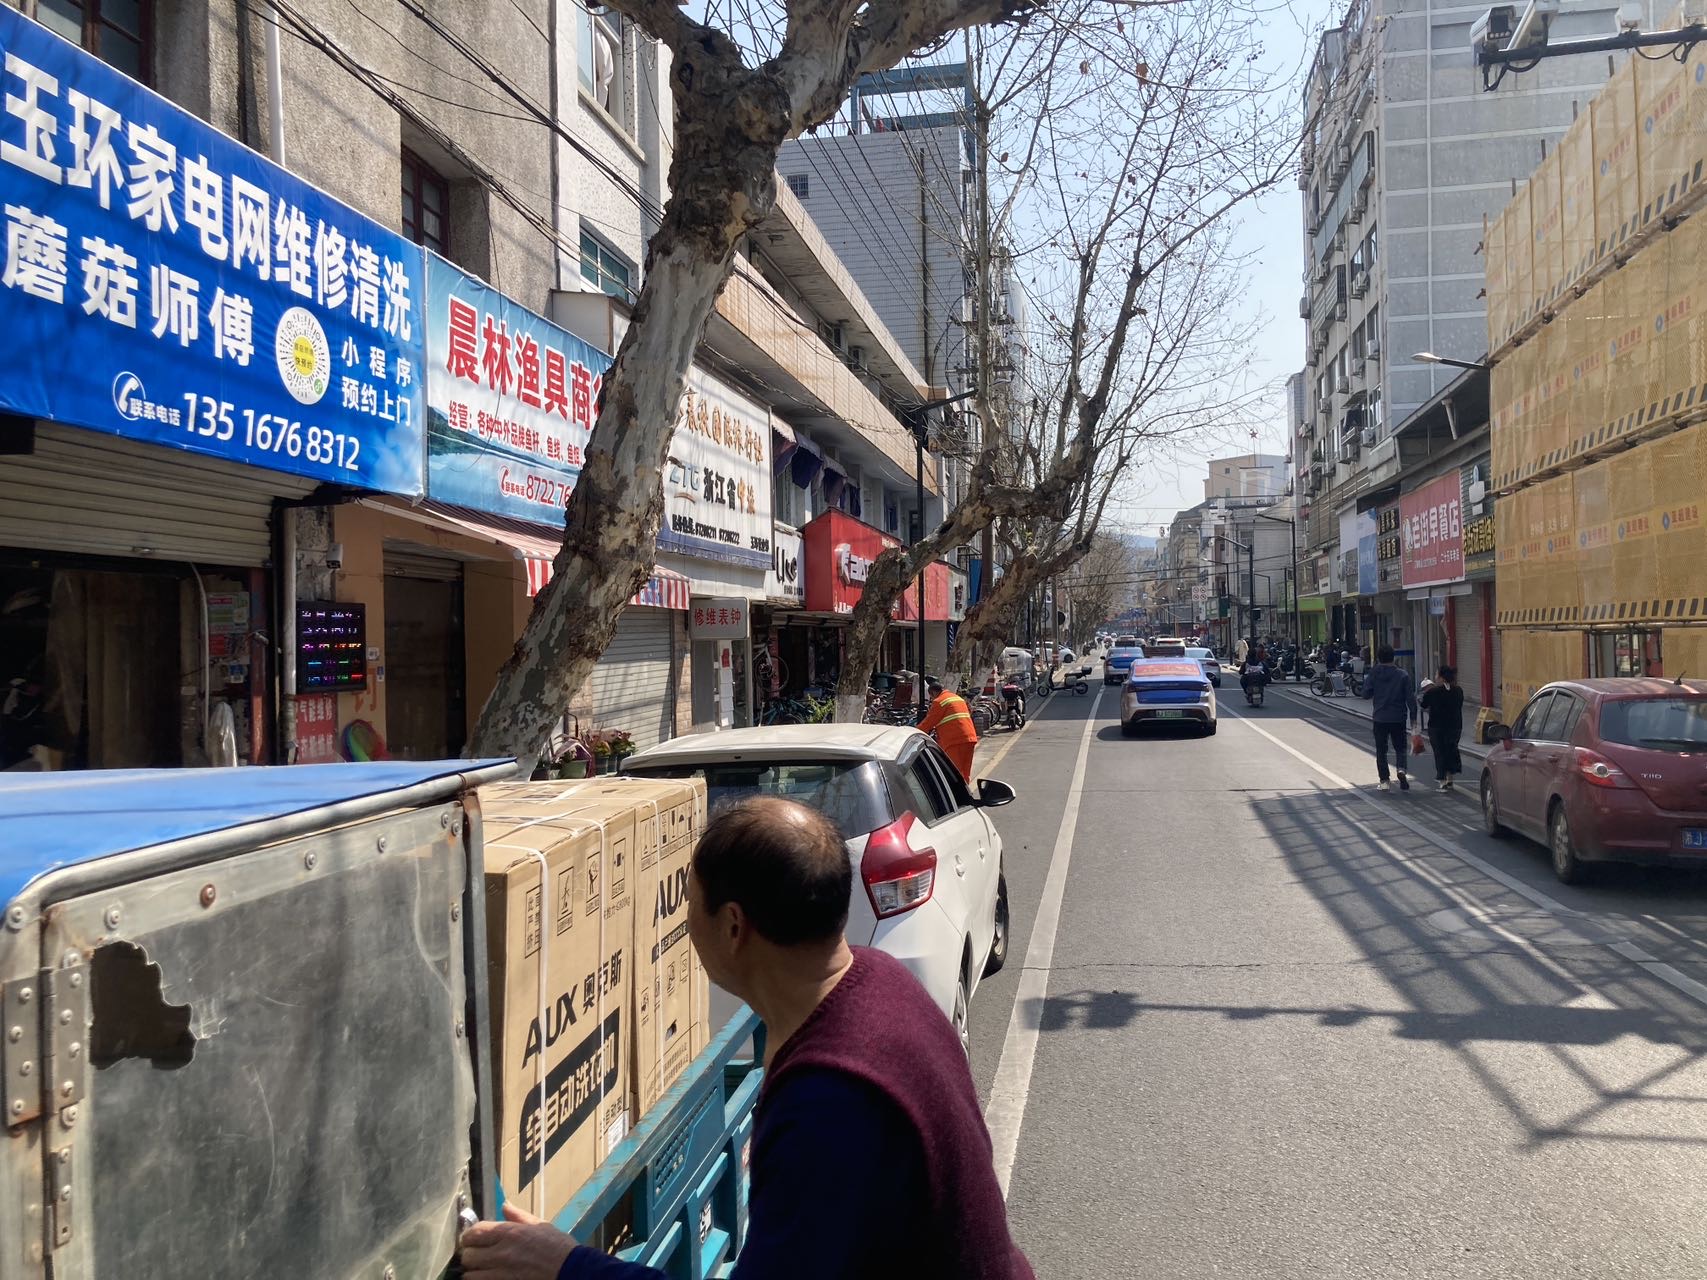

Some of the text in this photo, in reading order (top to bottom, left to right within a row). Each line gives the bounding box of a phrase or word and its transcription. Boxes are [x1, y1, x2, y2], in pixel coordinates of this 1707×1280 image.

[0, 52, 412, 342] 玉环家电网维修清洗
[1, 205, 256, 367] 蘑菇师傅
[341, 336, 412, 387] 小程序
[129, 392, 360, 471] 联系电话 135 1676 8312
[341, 376, 412, 427] 预约上门
[527, 475, 554, 504] 8722
[1412, 499, 1460, 549] 老街早餐店
[653, 862, 691, 928] AUX
[522, 948, 623, 1070] AUX 奥克斯
[525, 1032, 615, 1162] 全自动洗衣机
